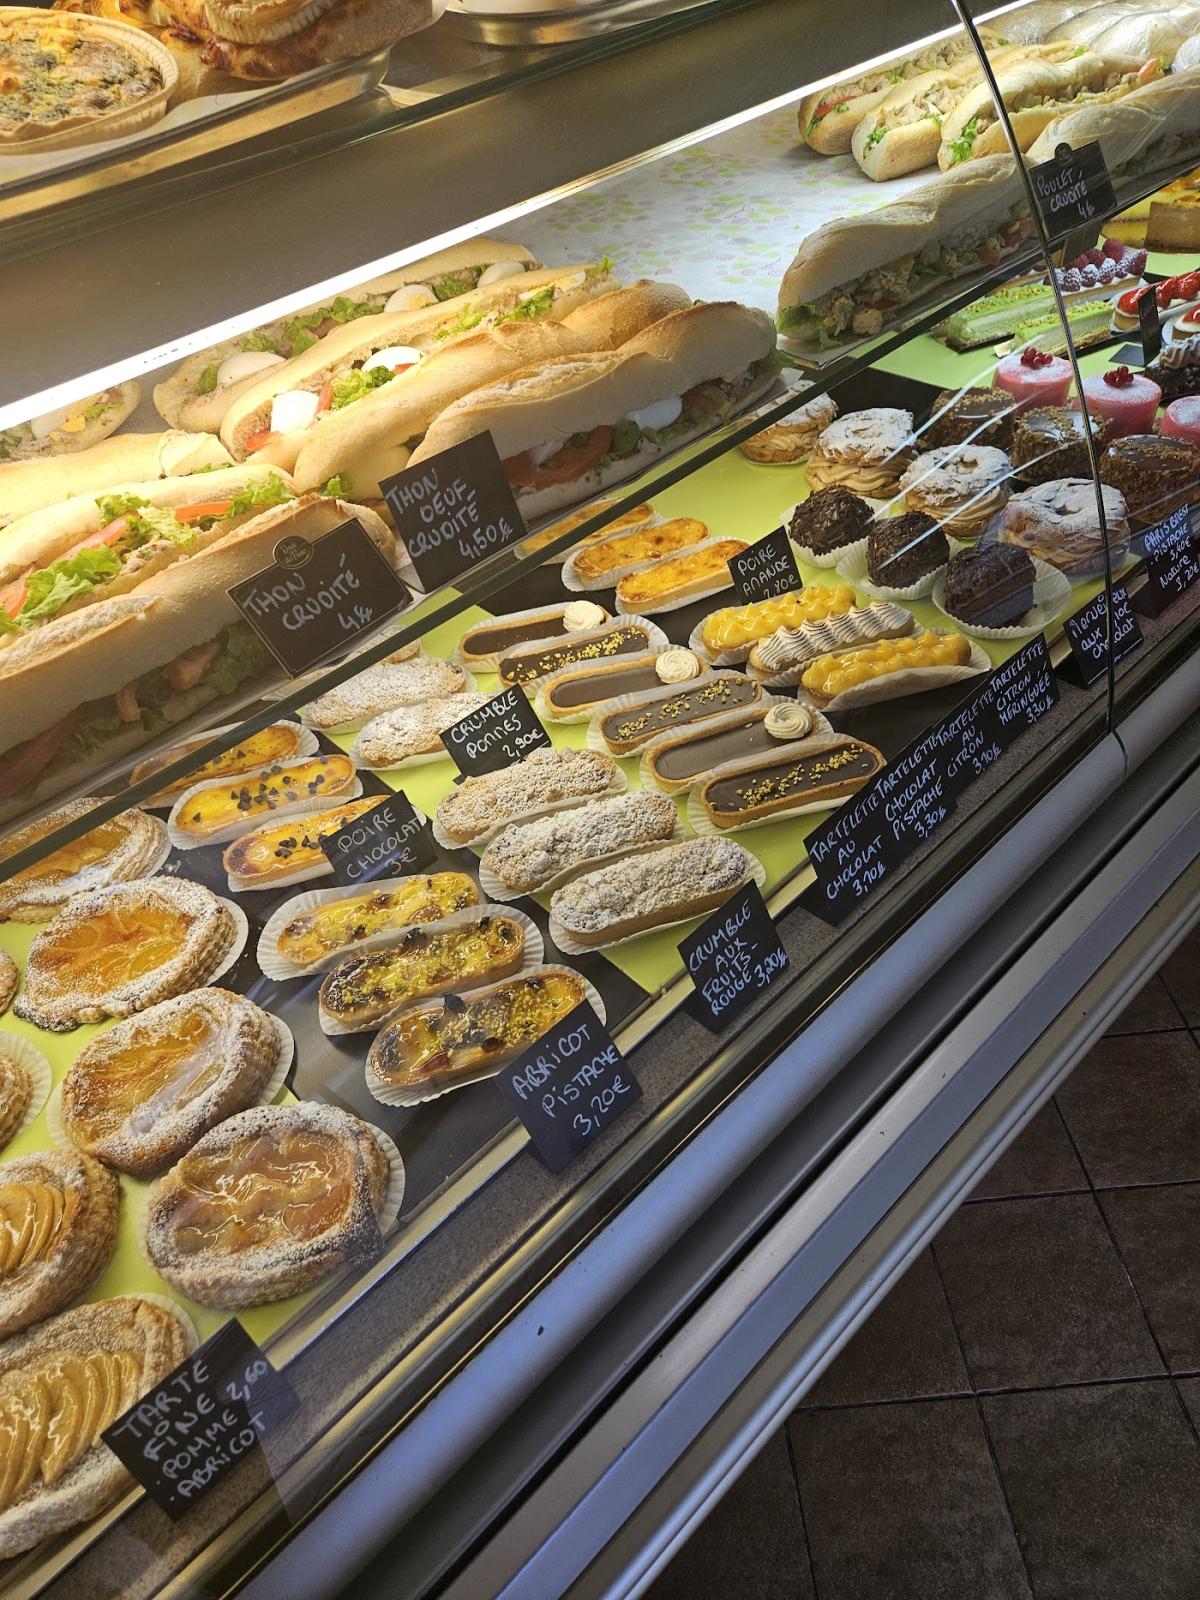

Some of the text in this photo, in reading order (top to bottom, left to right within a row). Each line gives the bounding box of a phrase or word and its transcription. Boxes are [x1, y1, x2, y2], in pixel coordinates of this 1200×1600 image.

[1037, 167, 1073, 197] POULET
[385, 467, 440, 514] THON
[419, 477, 468, 524] OEUF
[458, 516, 514, 559] 4,50€
[737, 543, 777, 577] POIRE
[242, 571, 307, 617] THON
[1159, 554, 1192, 589] Nature
[1081, 626, 1103, 652] aux
[990, 640, 1044, 693] TARTELETTE
[996, 671, 1032, 712] CITRON
[450, 690, 519, 744] CRUMBLE
[935, 688, 995, 747] TARTELETTE
[961, 724, 976, 747] AU
[502, 728, 545, 758] 2,90€
[873, 732, 939, 800] TARTELETTE
[946, 730, 985, 778] CITRON
[884, 757, 938, 823] CHOCOLAT
[337, 806, 396, 854] POIRE
[346, 816, 421, 878] CHOCOLAT
[809, 792, 880, 863] TARTELETTE
[384, 846, 417, 876] 3€
[826, 834, 883, 901] CHOCOLAT
[837, 839, 857, 865] AU
[689, 897, 752, 973] CRUMBLE
[715, 936, 748, 973] AUX
[710, 964, 752, 1016] ROUGE
[511, 1023, 591, 1100] ABRICOT
[541, 1044, 620, 1119] PISTACHE
[572, 1074, 632, 1137] 3,20€
[111, 1359, 210, 1439] TARTE
[143, 1392, 216, 1462] FINE
